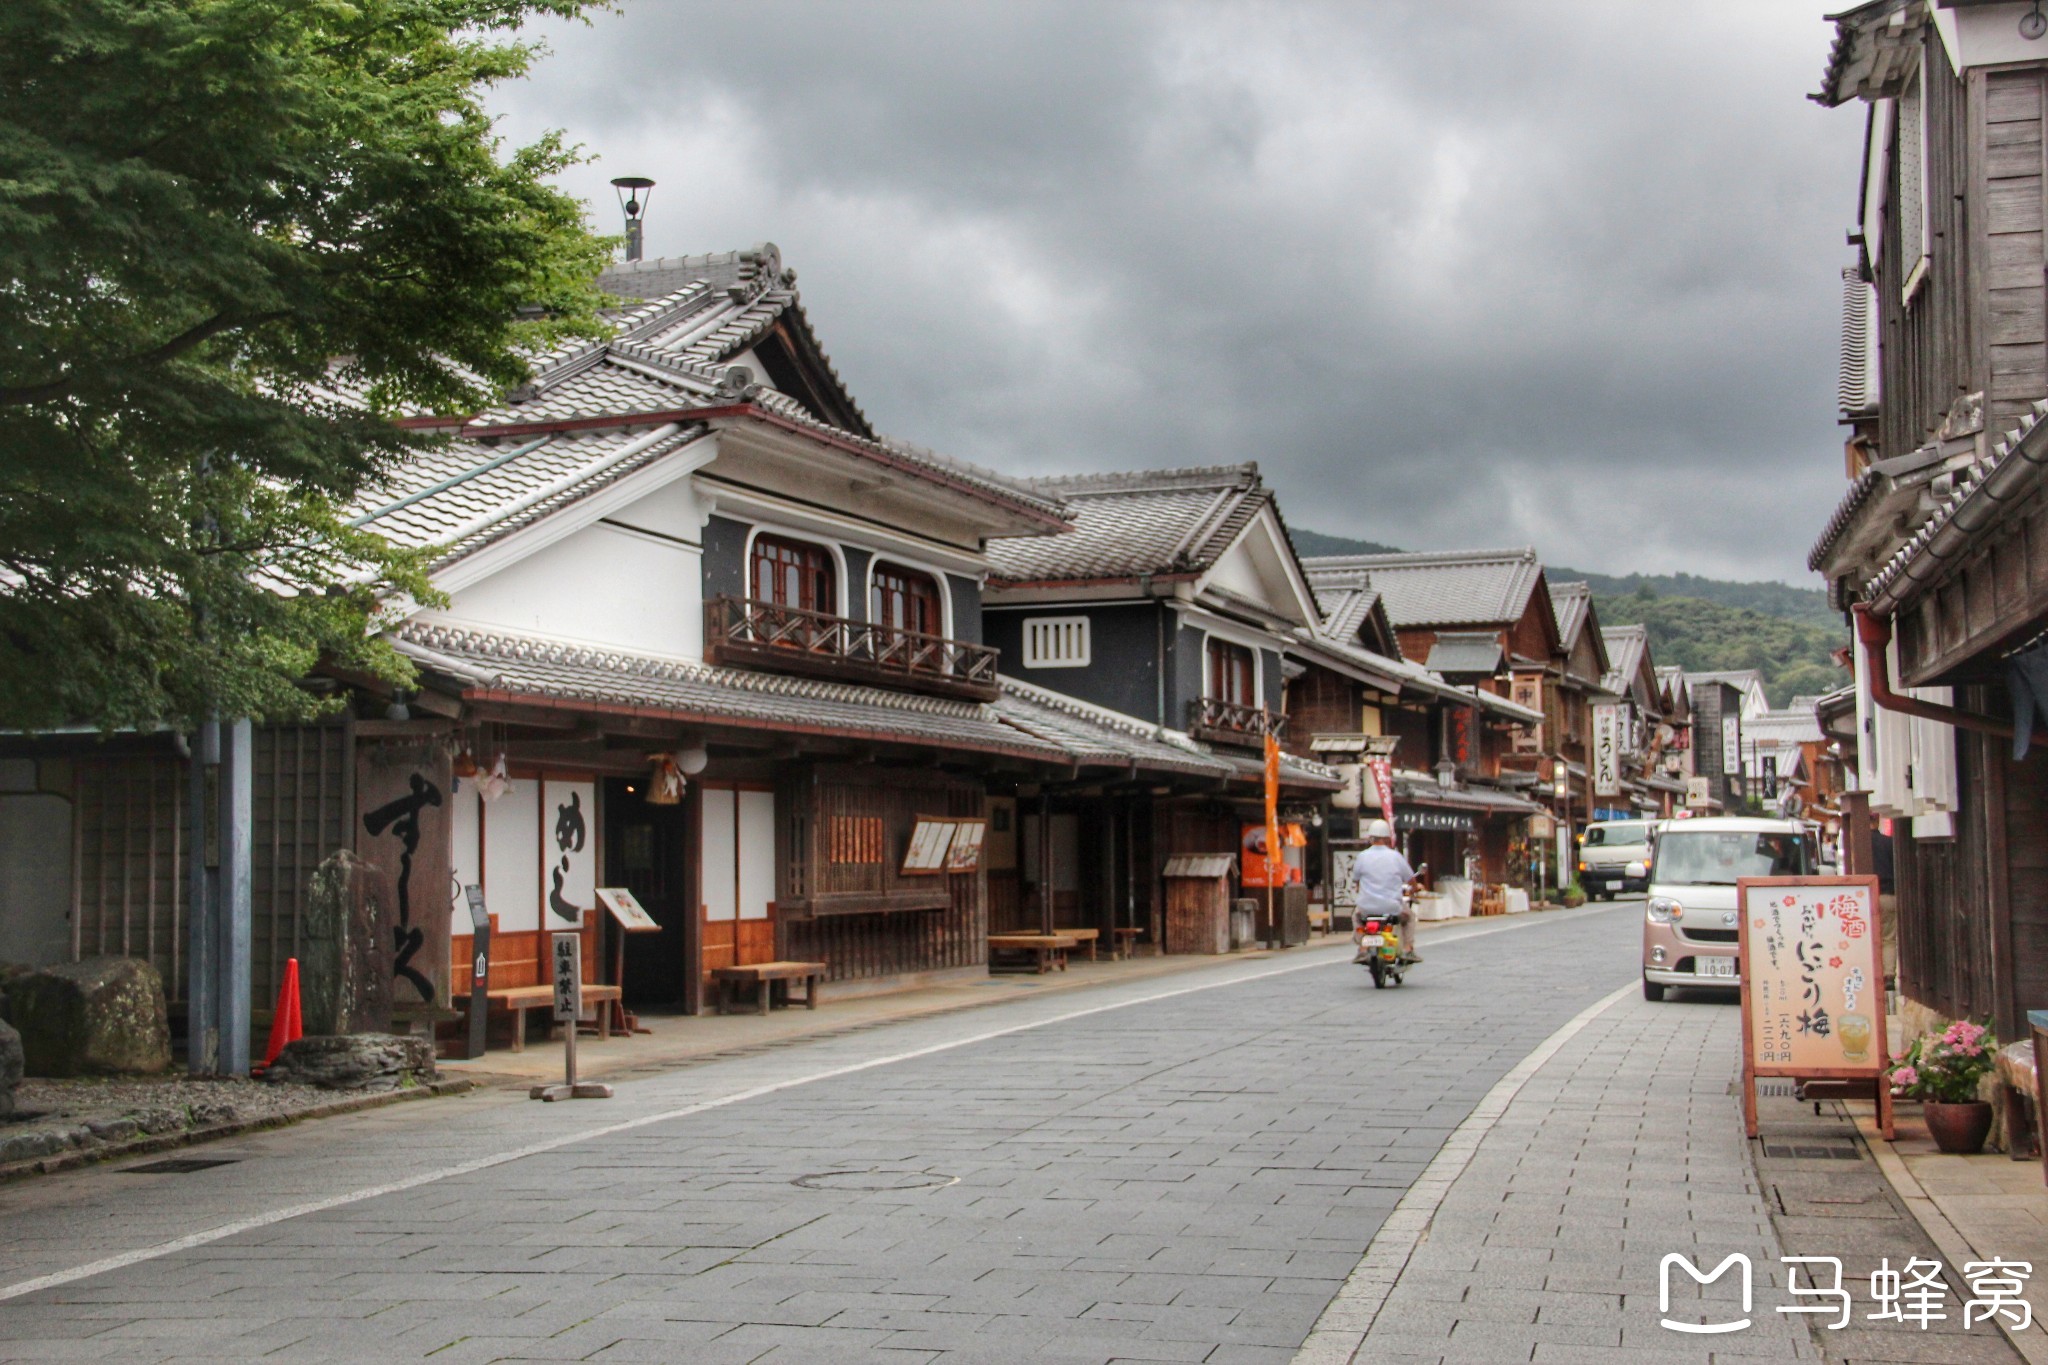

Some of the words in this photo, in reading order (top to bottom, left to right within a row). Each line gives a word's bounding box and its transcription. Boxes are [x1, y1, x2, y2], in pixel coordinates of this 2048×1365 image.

[549, 790, 586, 923] めし
[1829, 894, 1867, 939] 梅酒
[556, 940, 573, 1013] 駐車禁止
[1796, 940, 1830, 1040] にごり梅
